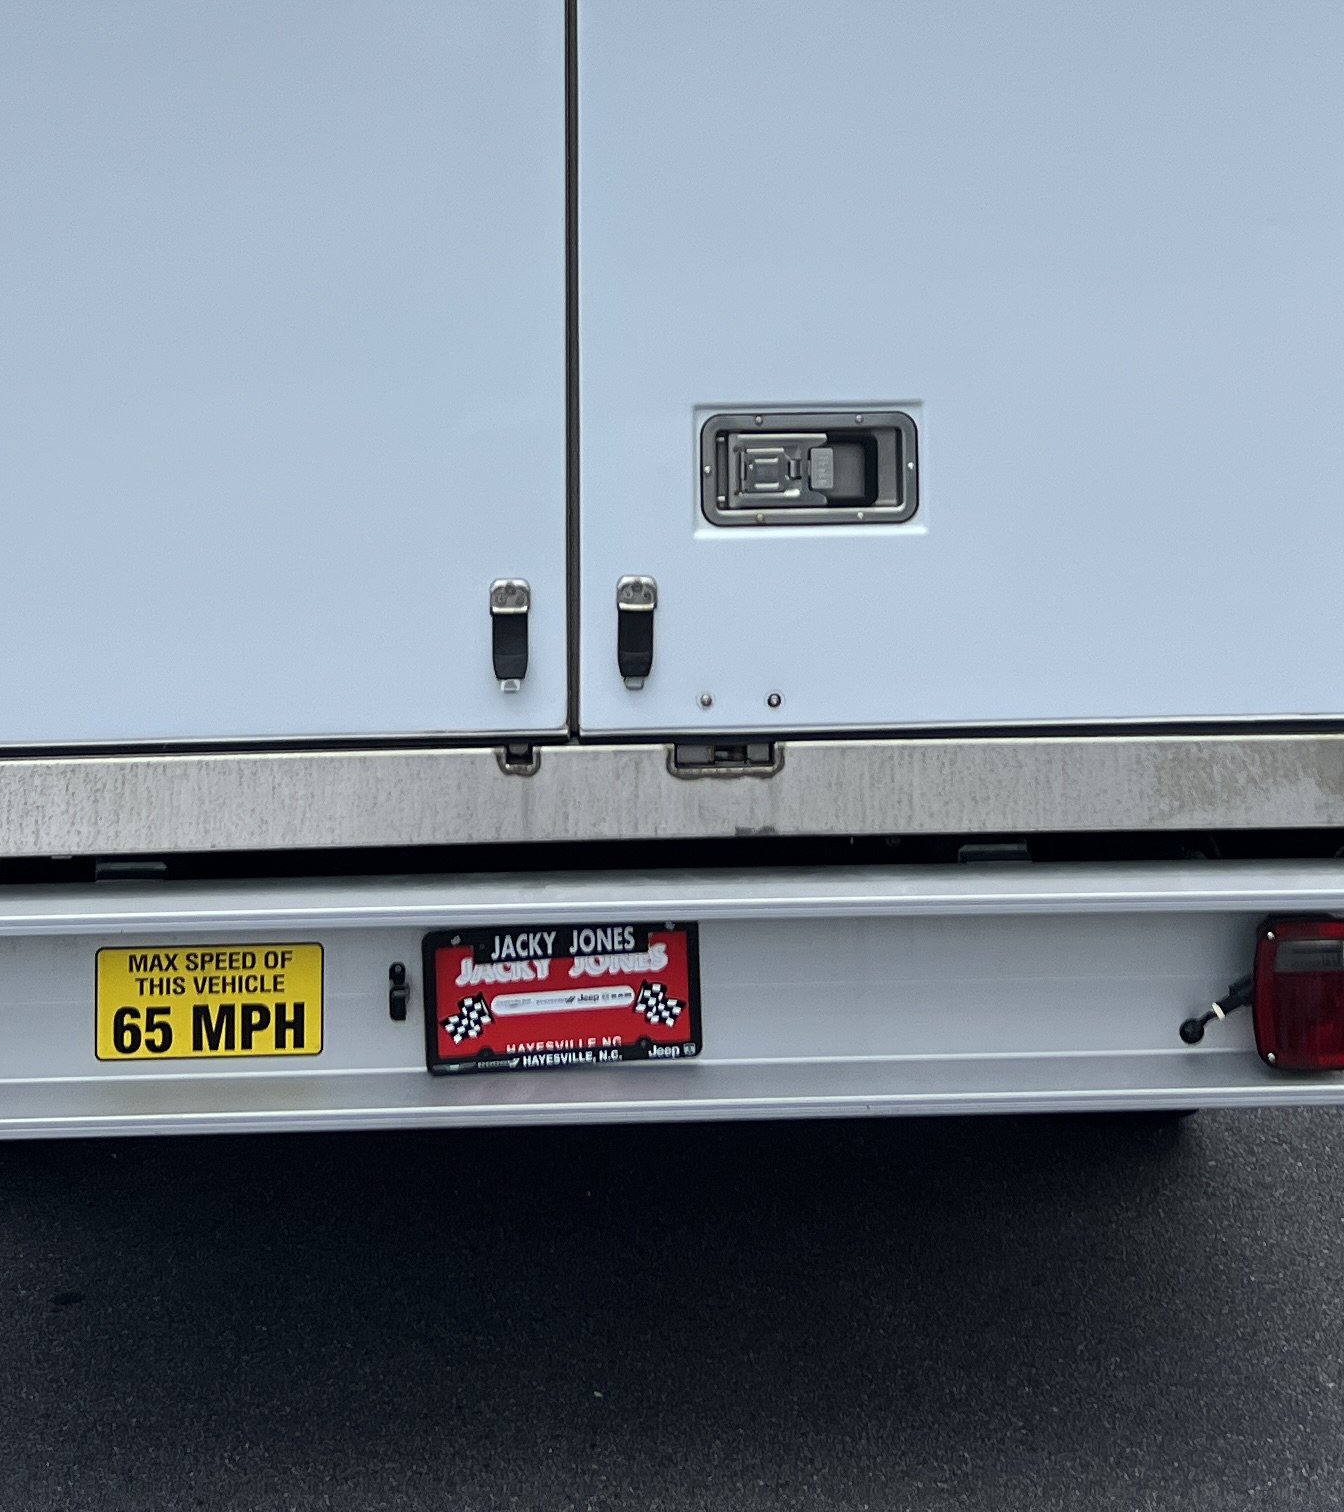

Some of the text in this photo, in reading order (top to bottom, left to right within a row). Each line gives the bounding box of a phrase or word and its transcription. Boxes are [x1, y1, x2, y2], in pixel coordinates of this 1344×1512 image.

[491, 926, 636, 960] JACKY JONES
[128, 950, 293, 973] MAX SPEED OF
[135, 974, 286, 996] THIS VEHICLE
[113, 1001, 306, 1054] 65 MPH
[648, 1044, 680, 1059] Jeep
